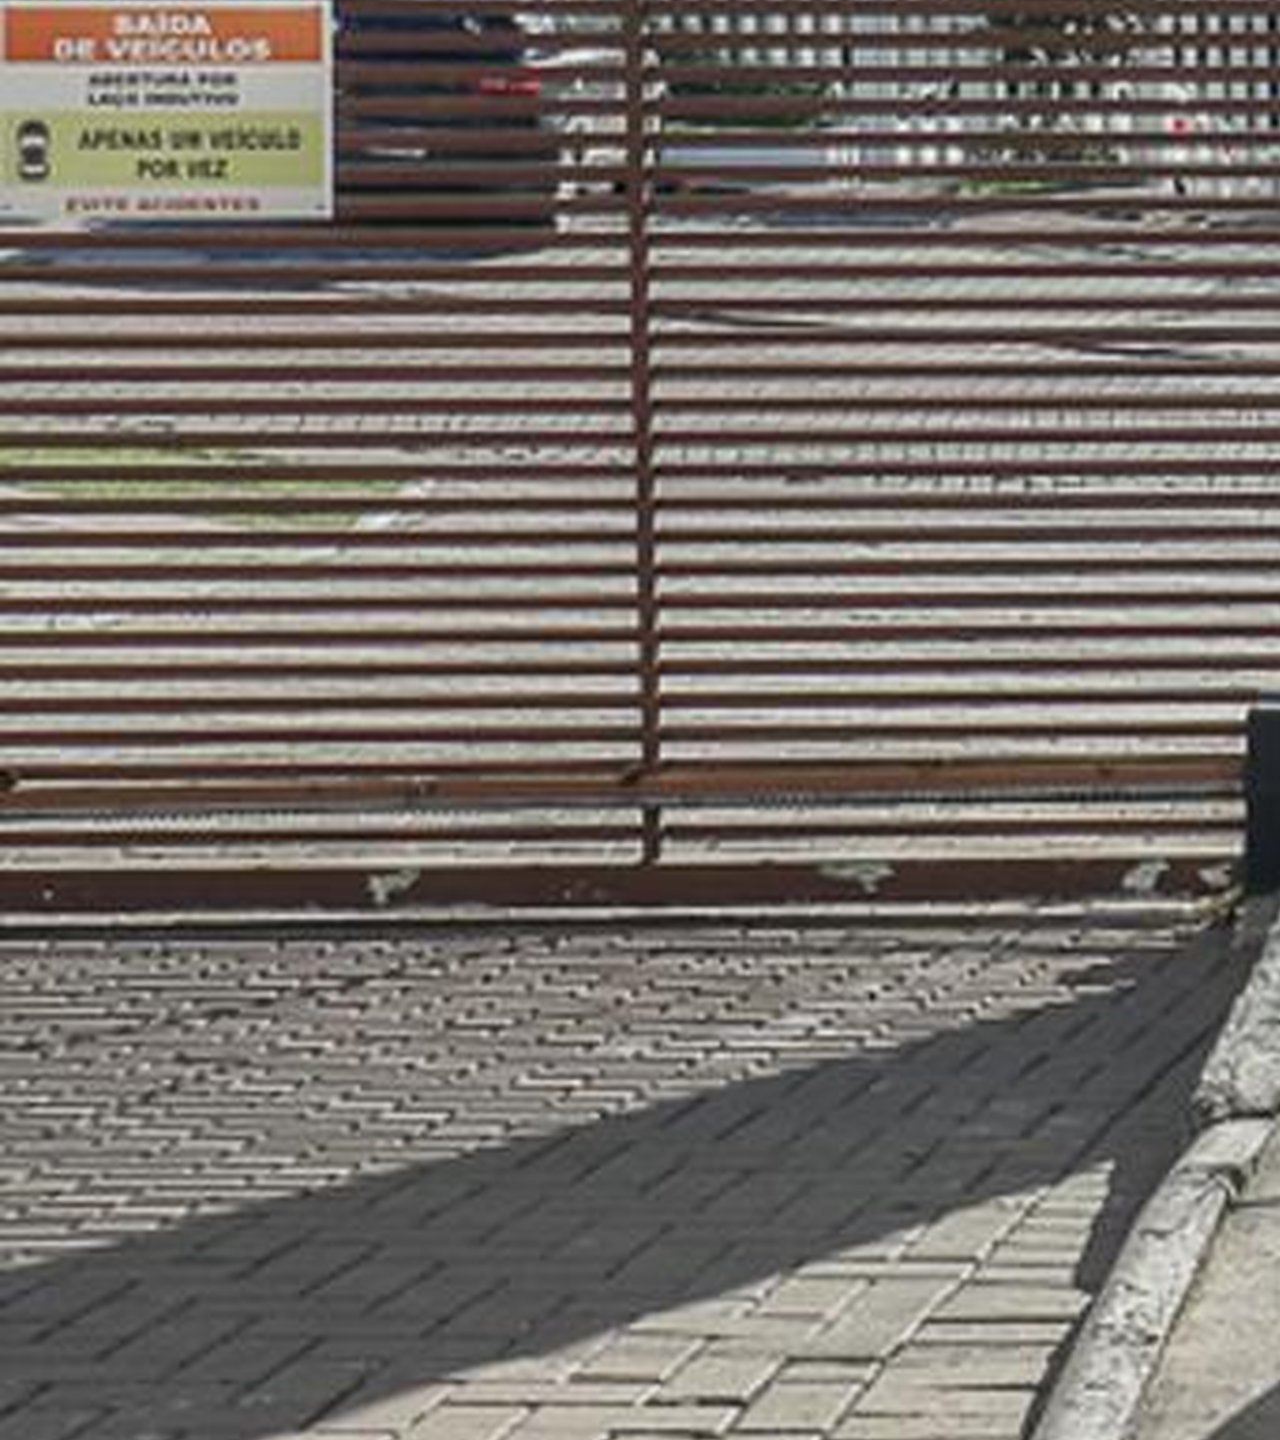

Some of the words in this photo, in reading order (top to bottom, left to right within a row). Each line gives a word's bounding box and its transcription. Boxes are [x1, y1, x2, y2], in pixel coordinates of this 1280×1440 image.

[113, 7, 211, 34] SAÍDA
[54, 37, 95, 59] DE
[199, 73, 237, 86] POR
[78, 129, 162, 150] APENAS
[136, 159, 180, 178] POR
[187, 159, 228, 178] VEZ
